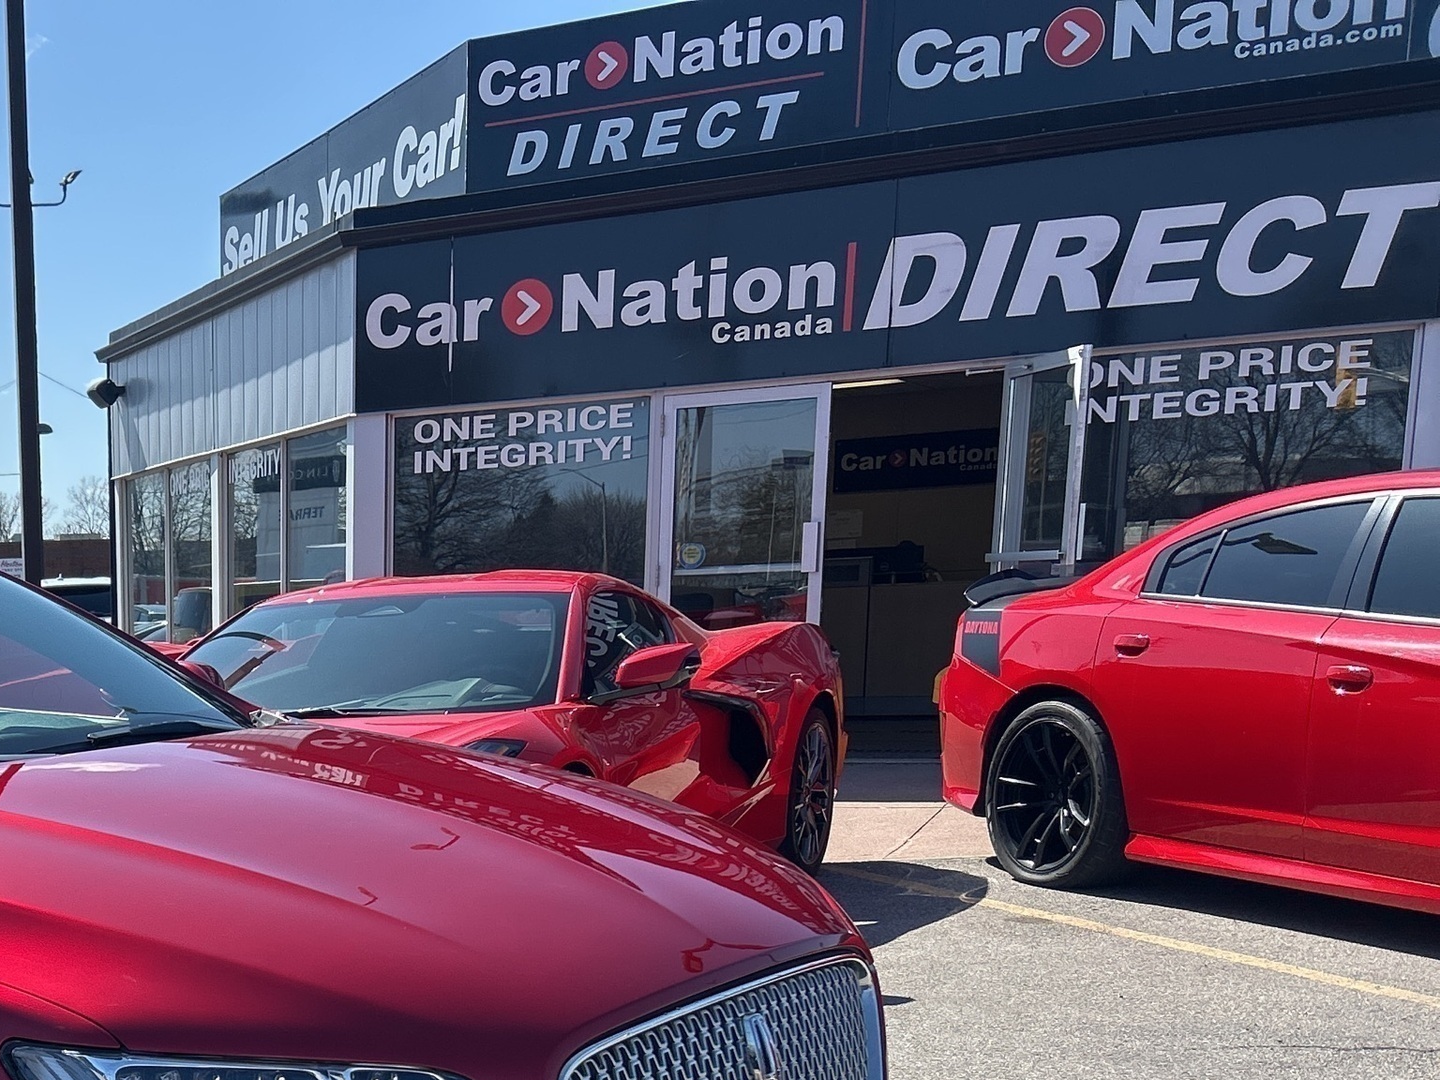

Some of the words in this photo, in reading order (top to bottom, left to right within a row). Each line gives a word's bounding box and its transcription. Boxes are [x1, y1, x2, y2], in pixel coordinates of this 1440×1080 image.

[478, 59, 579, 106] Car
[632, 14, 844, 82] Nation
[897, 27, 1040, 90] Car
[1234, 21, 1403, 59] Canada.com
[506, 90, 800, 177] DIRECT
[223, 210, 268, 275] Sell
[275, 193, 309, 243] Us
[317, 155, 387, 220] Your
[393, 93, 466, 198] Car!
[862, 181, 1440, 332] DIRECT
[365, 292, 494, 350] Car
[561, 256, 837, 333] Nation
[711, 313, 833, 345] Canada
[1198, 339, 1374, 381] PRICE
[413, 411, 497, 444] ONE
[508, 402, 633, 437] PRICE
[1064, 377, 1368, 426] INTEGRITY!
[413, 434, 632, 475] INTEGRITY!
[840, 452, 887, 472] Car
[964, 621, 999, 635] DAYTONA
